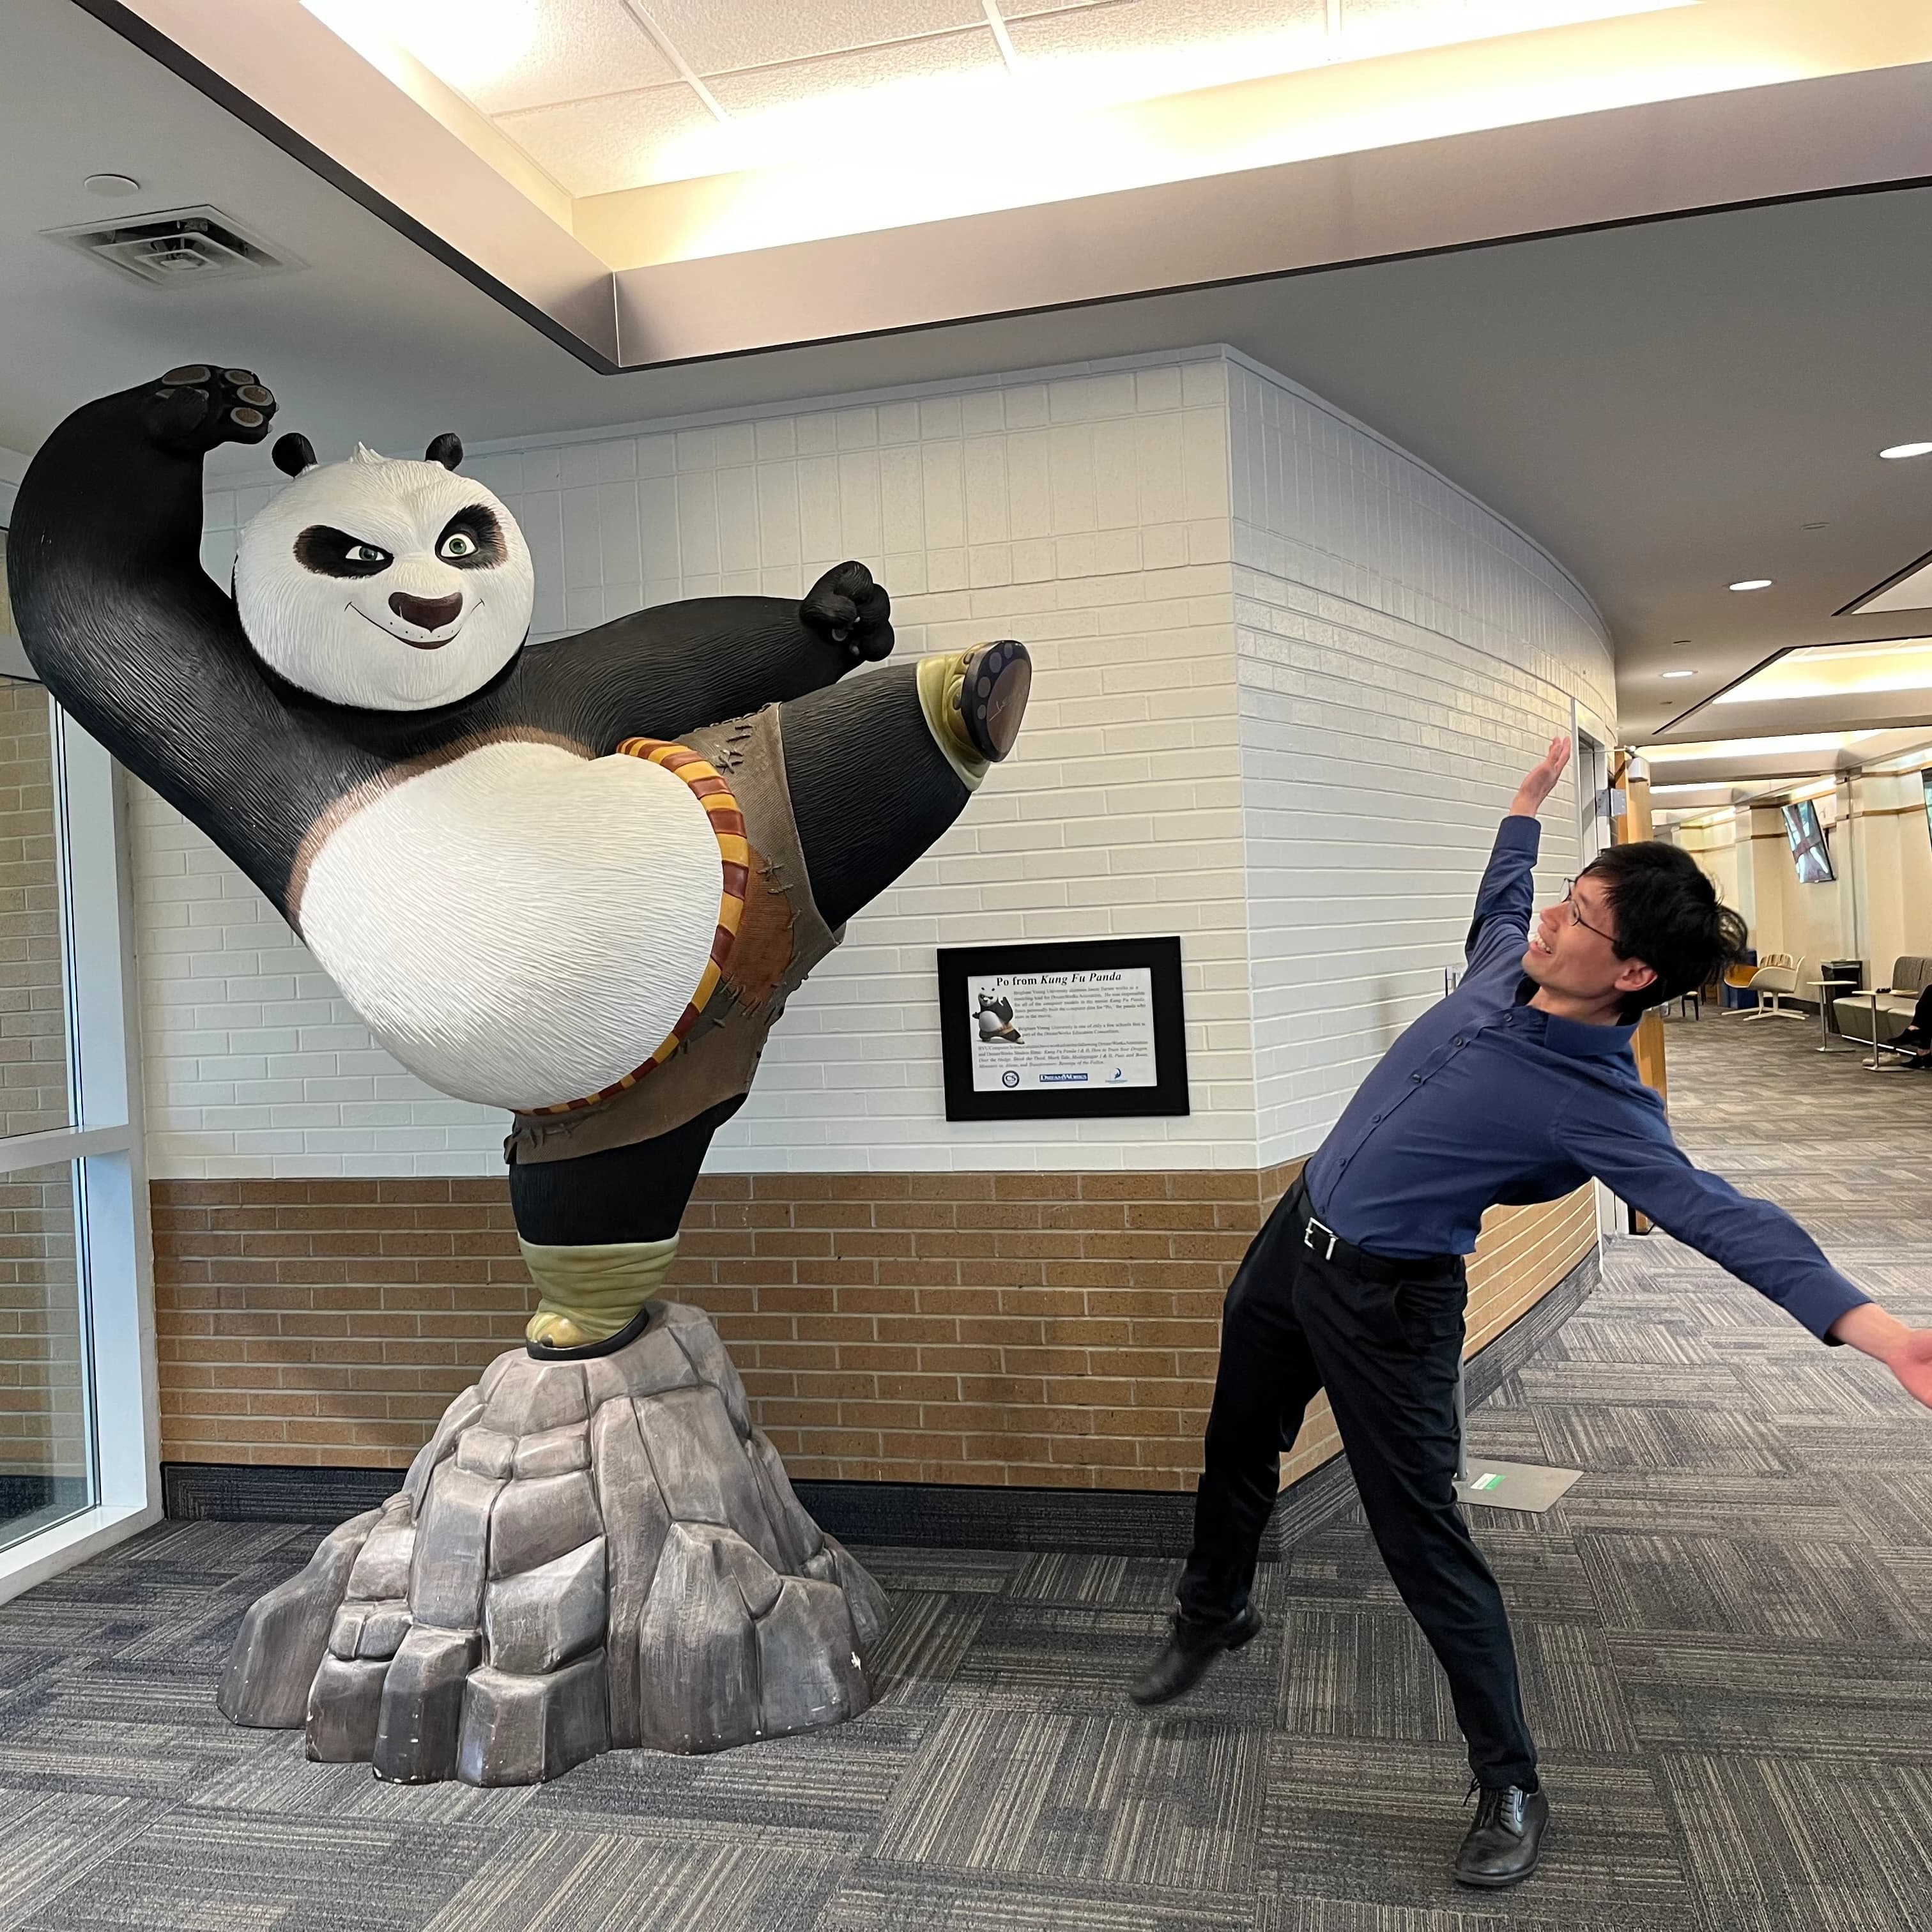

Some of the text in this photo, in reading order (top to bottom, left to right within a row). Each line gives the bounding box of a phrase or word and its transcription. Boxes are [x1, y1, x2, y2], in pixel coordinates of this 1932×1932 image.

[997, 971, 1121, 986] Po from Kung Fu Panda
